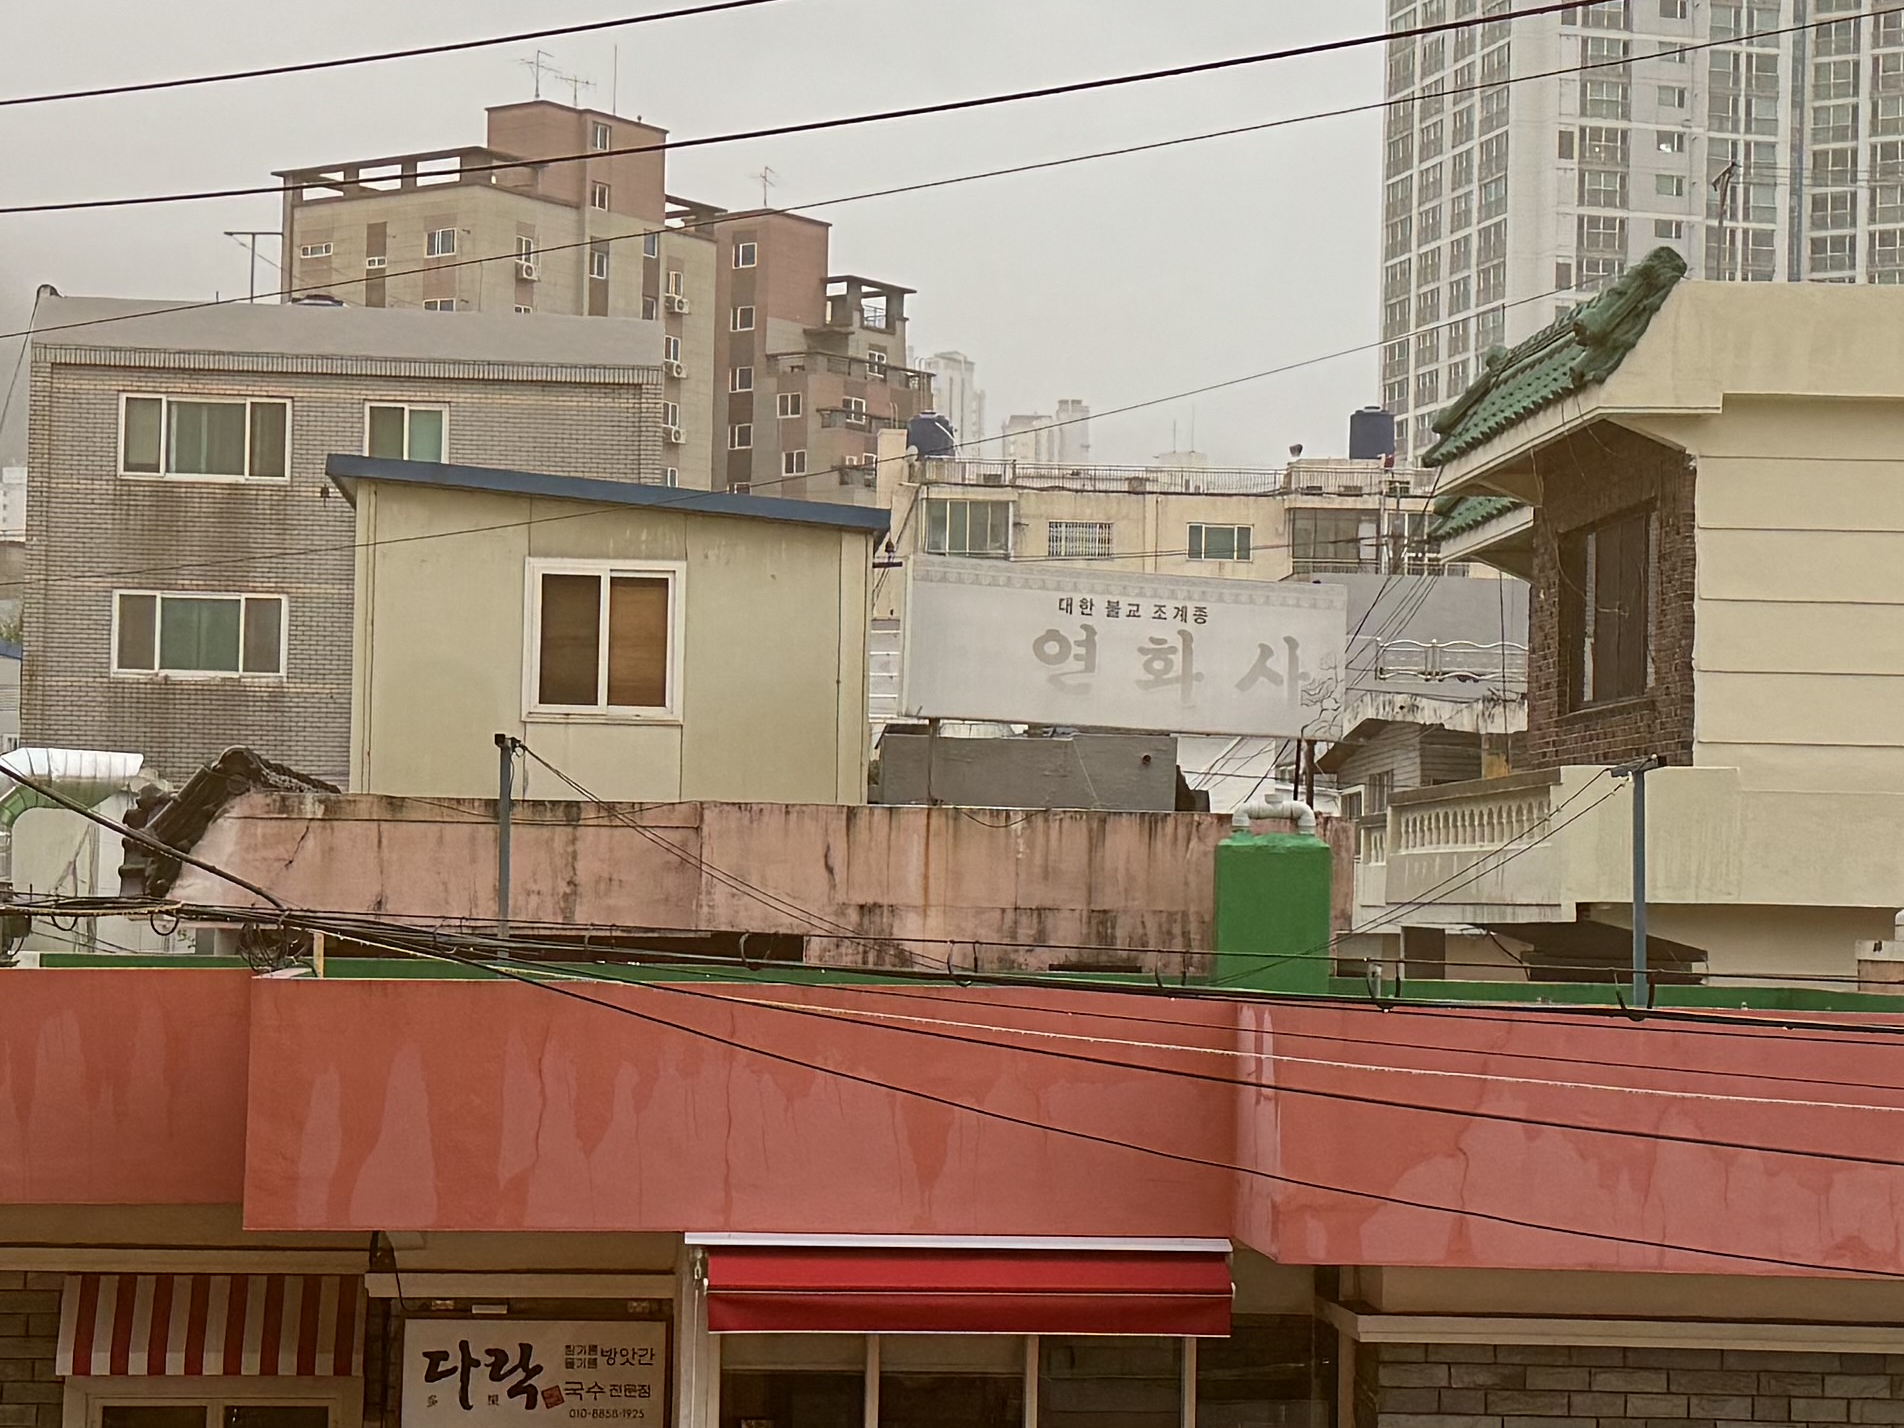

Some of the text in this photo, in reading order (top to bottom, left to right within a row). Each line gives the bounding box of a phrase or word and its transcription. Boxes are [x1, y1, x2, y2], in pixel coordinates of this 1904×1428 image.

[1058, 597, 1208, 624] 대한 불교 조계종
[1032, 623, 1310, 709] 연화사
[600, 1347, 655, 1366] 방앗간
[422, 1339, 544, 1411] 다락
[564, 1381, 606, 1401] 국수
[609, 1384, 651, 1398] 전문점
